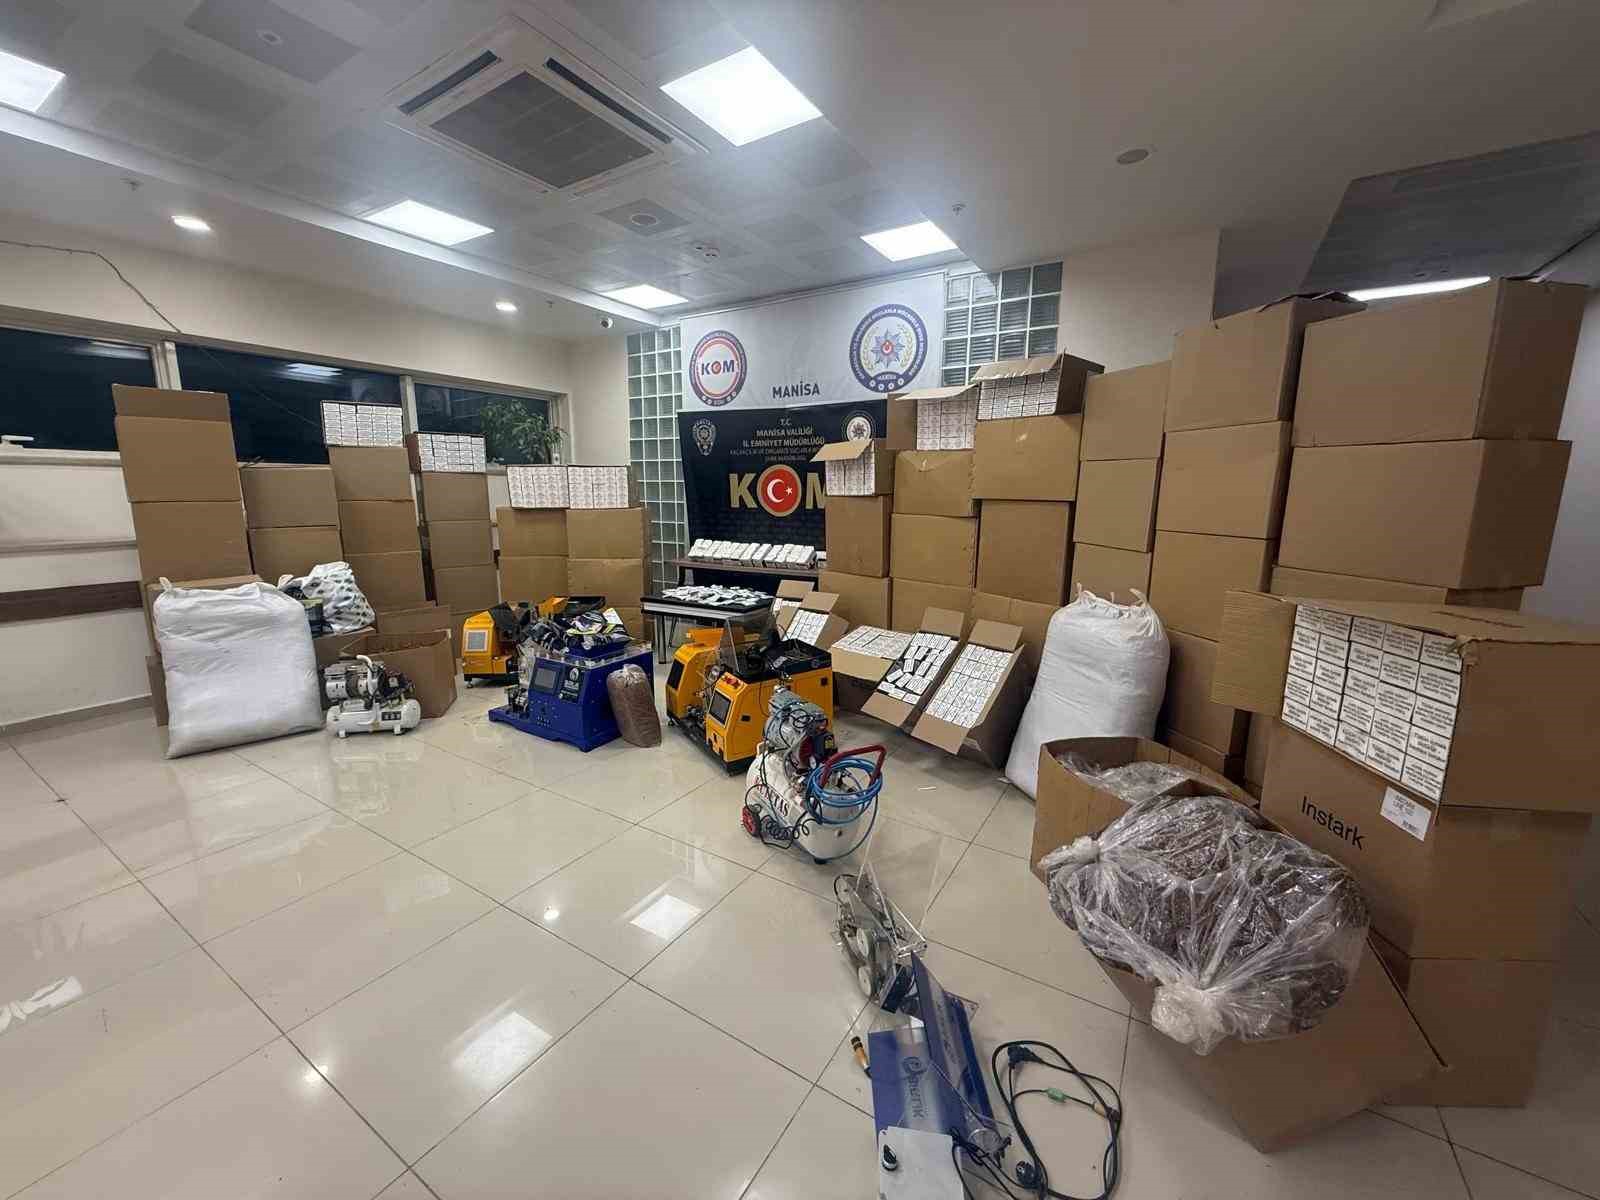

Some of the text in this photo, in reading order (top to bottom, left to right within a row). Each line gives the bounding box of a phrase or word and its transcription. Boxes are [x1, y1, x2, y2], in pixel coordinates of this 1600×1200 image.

[701, 360, 735, 375] KOM
[772, 381, 820, 398] MANİSA
[1302, 795, 1366, 851] Instark
